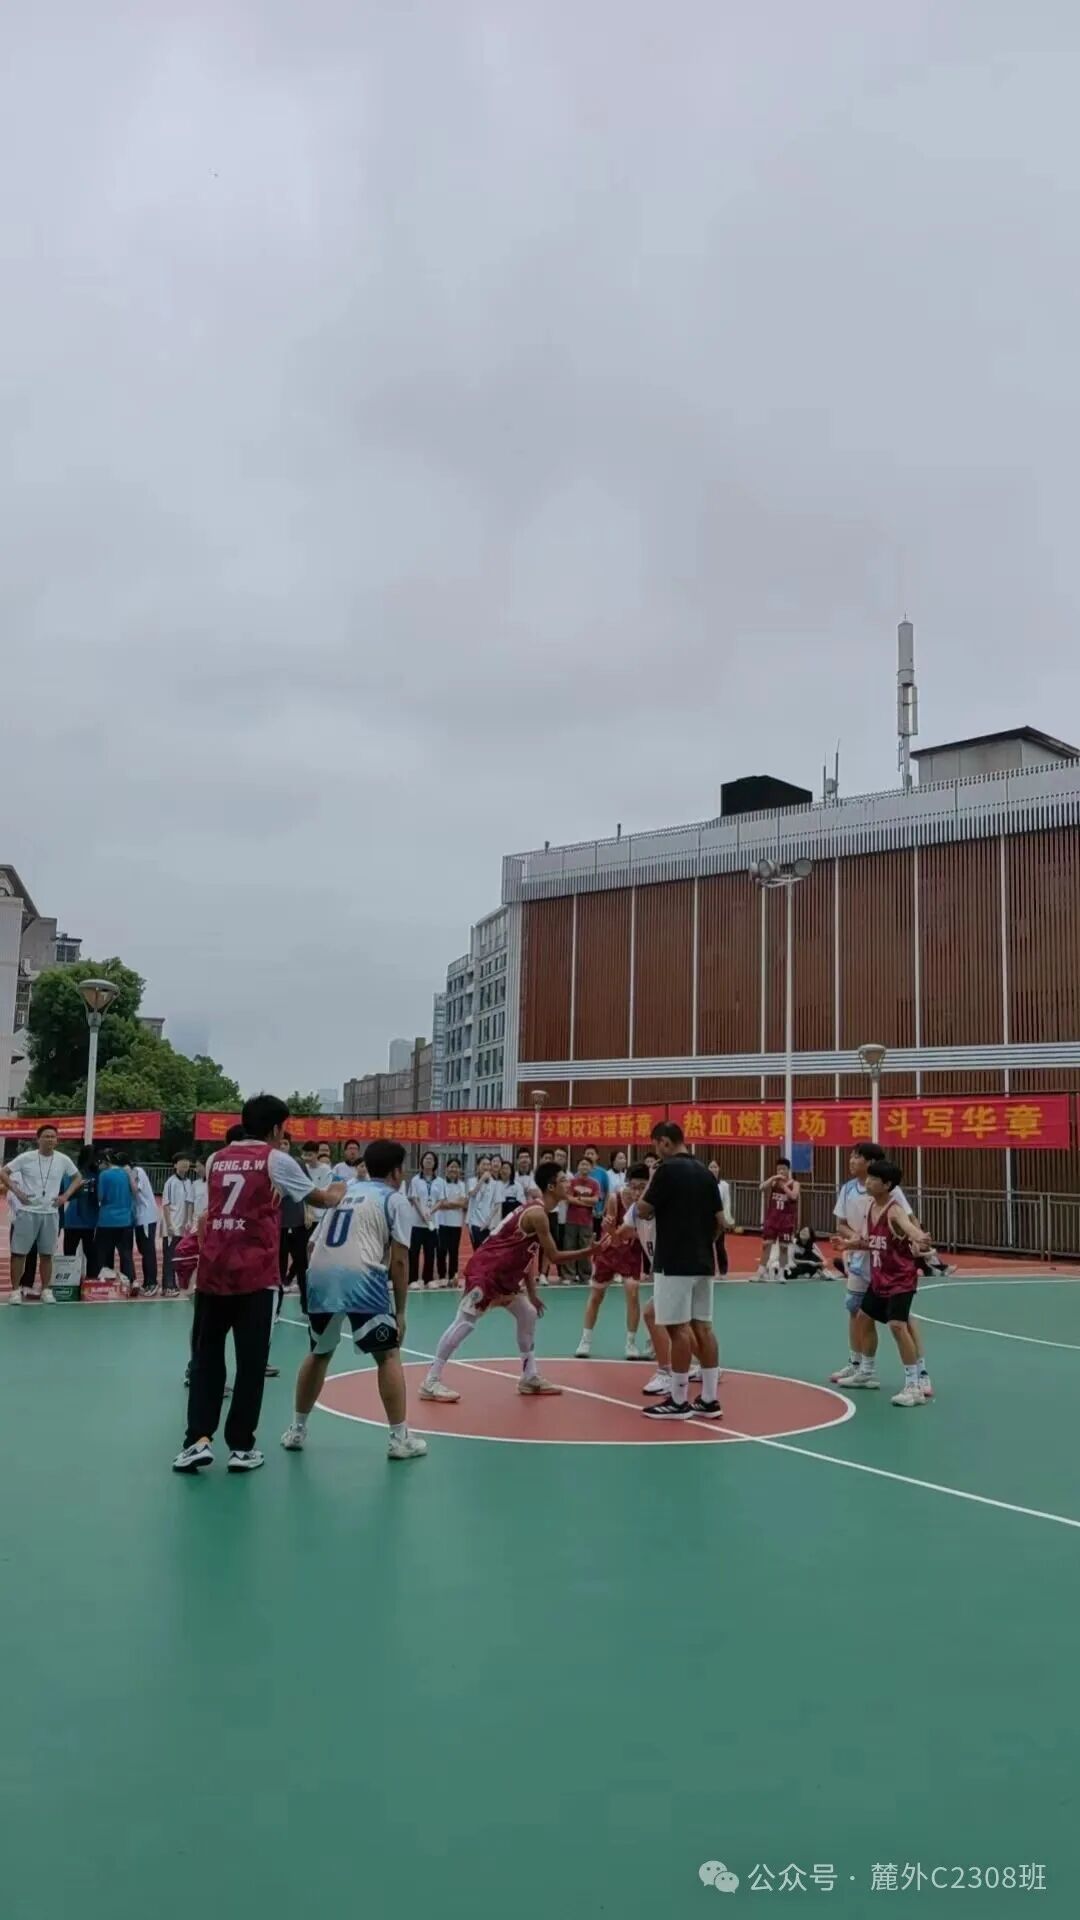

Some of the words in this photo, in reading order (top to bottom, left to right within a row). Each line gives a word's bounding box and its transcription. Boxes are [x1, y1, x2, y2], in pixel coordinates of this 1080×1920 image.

[683, 1109, 826, 1138] 热血燃赛场
[850, 1104, 1043, 1140] 奋斗写华章
[212, 1160, 266, 1172] PENG.B.W
[221, 1173, 246, 1215] 7
[326, 1208, 354, 1248] 0
